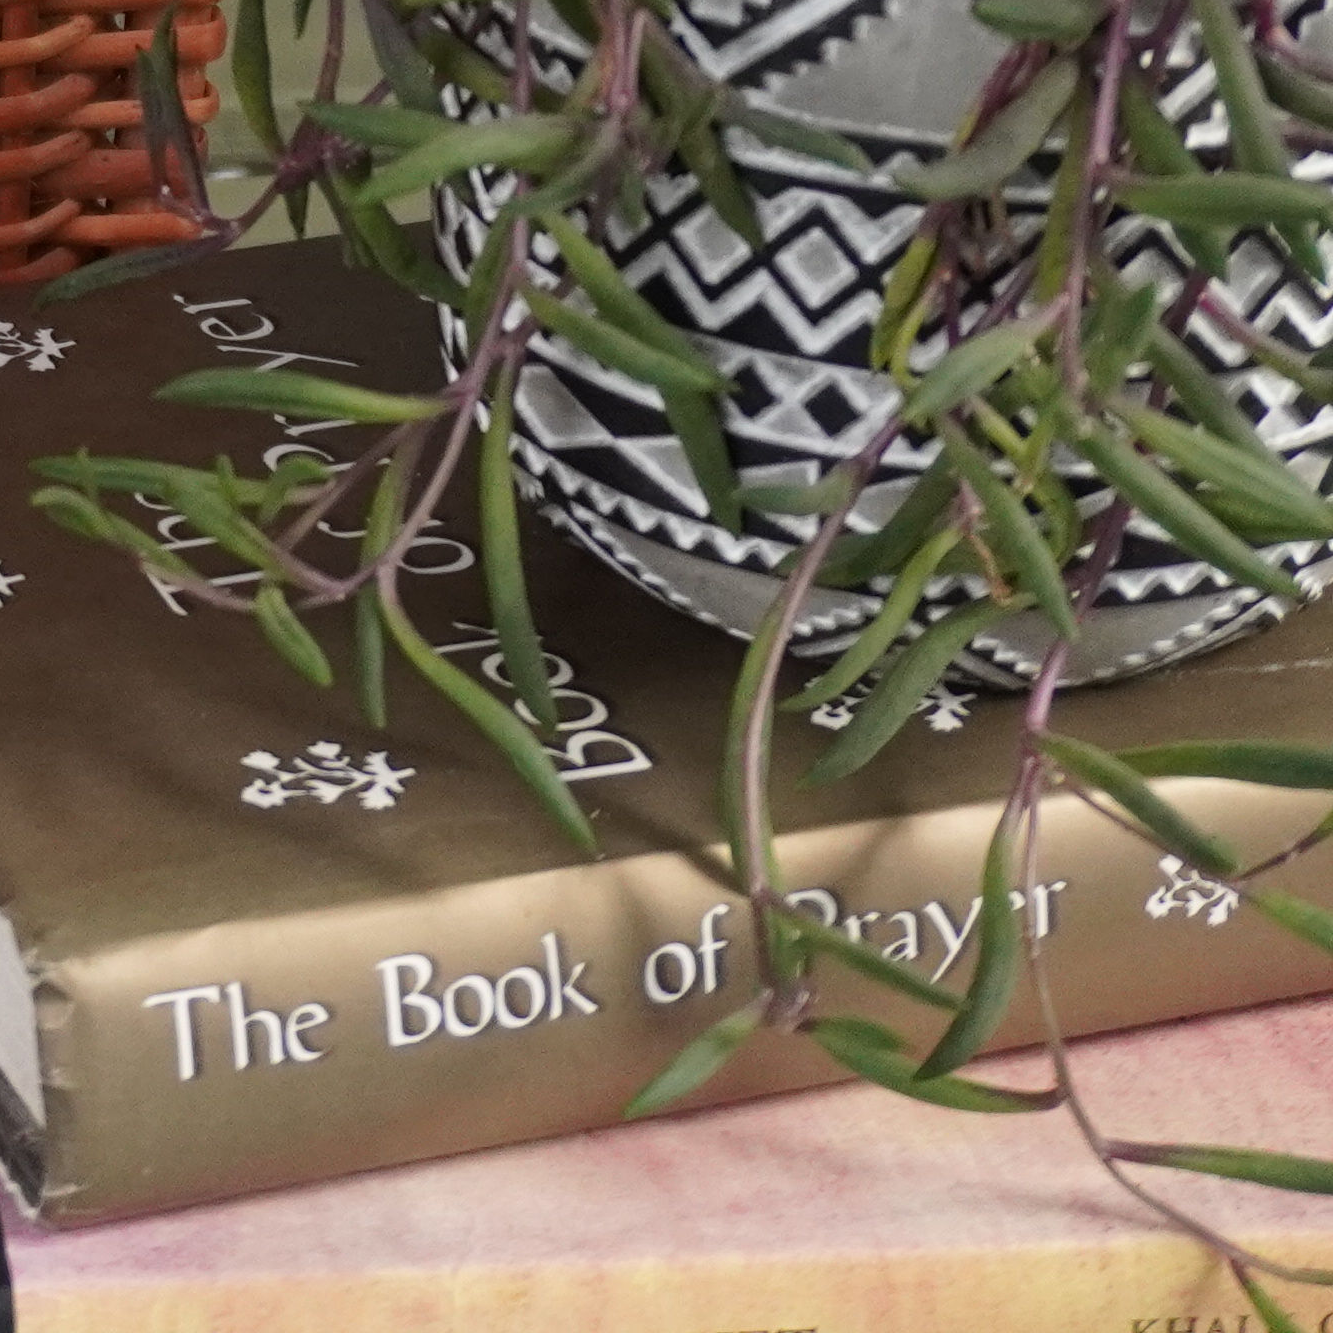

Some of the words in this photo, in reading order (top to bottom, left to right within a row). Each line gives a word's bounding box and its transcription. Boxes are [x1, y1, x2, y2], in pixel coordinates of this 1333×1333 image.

[173, 294, 392, 473] Pryer
[142, 981, 329, 1082] The
[375, 933, 599, 1047] Book
[643, 903, 731, 1004] of
[784, 881, 1067, 985] rayr
